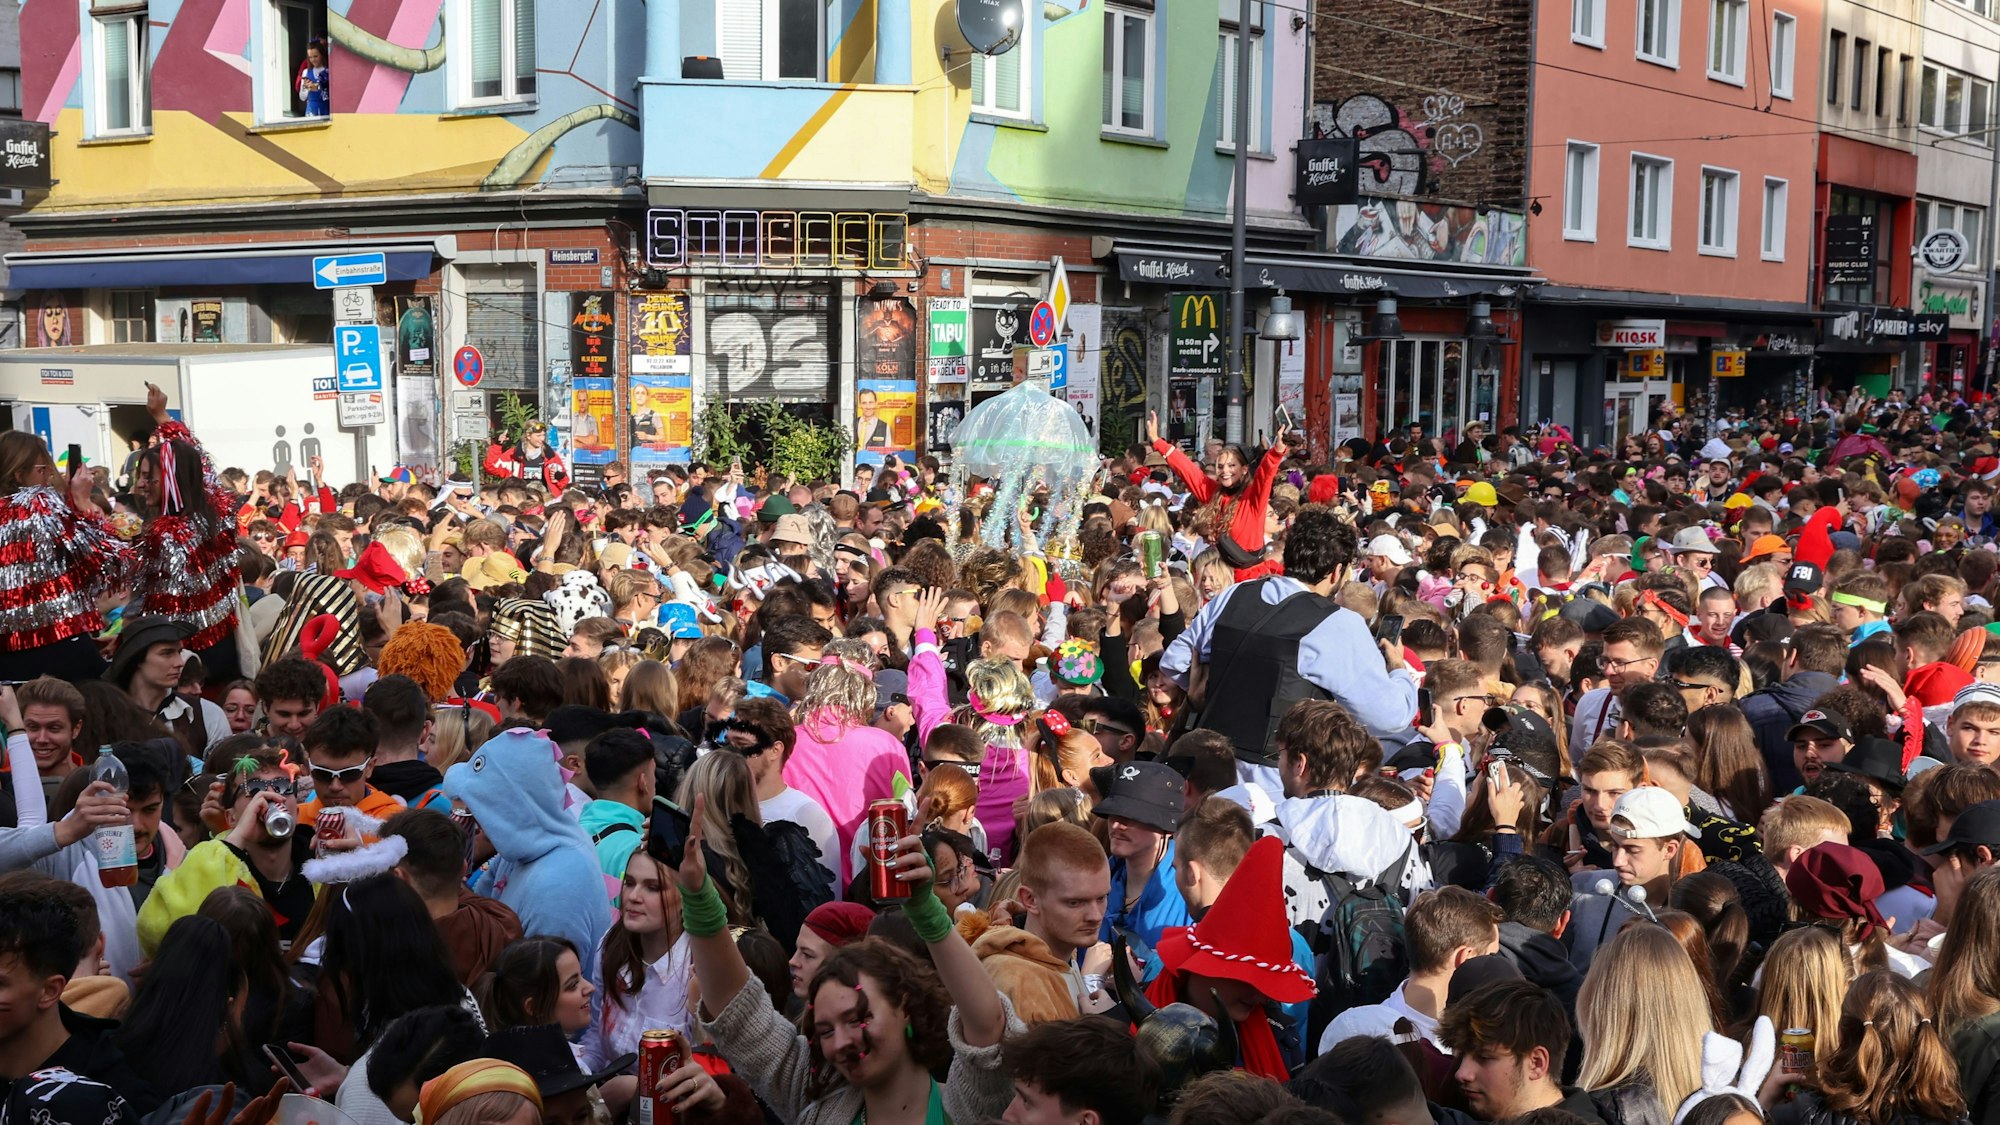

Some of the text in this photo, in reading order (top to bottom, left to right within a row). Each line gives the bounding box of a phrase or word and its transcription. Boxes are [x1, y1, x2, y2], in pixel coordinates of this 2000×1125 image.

[6, 139, 38, 155] Gaffel
[5, 154, 39, 169] Kölsch
[1308, 157, 1339, 172] Gaffel
[1306, 171, 1339, 186] Kölsch
[652, 213, 905, 264] STIEFEL
[552, 250, 594, 263] Heinsbergstr.
[335, 264, 381, 276] Einbahnstraße
[1139, 259, 1190, 279] Gaffel Kölsch
[1344, 273, 1366, 291] Gaffel
[638, 302, 685, 312] FREUNDE
[931, 300, 961, 310] READY TO
[933, 323, 963, 343] TABU
[1918, 320, 1944, 335] sky
[1177, 338, 1184, 346] in
[1185, 338, 1194, 346] 50
[1616, 332, 1656, 343] KIOSK
[1790, 345, 1815, 355] DELIVERY
[930, 357, 966, 366] SCHAUSPIEL
[938, 367, 956, 376] KOELN
[313, 379, 332, 390] TOI
[1792, 566, 1813, 581] FBI
